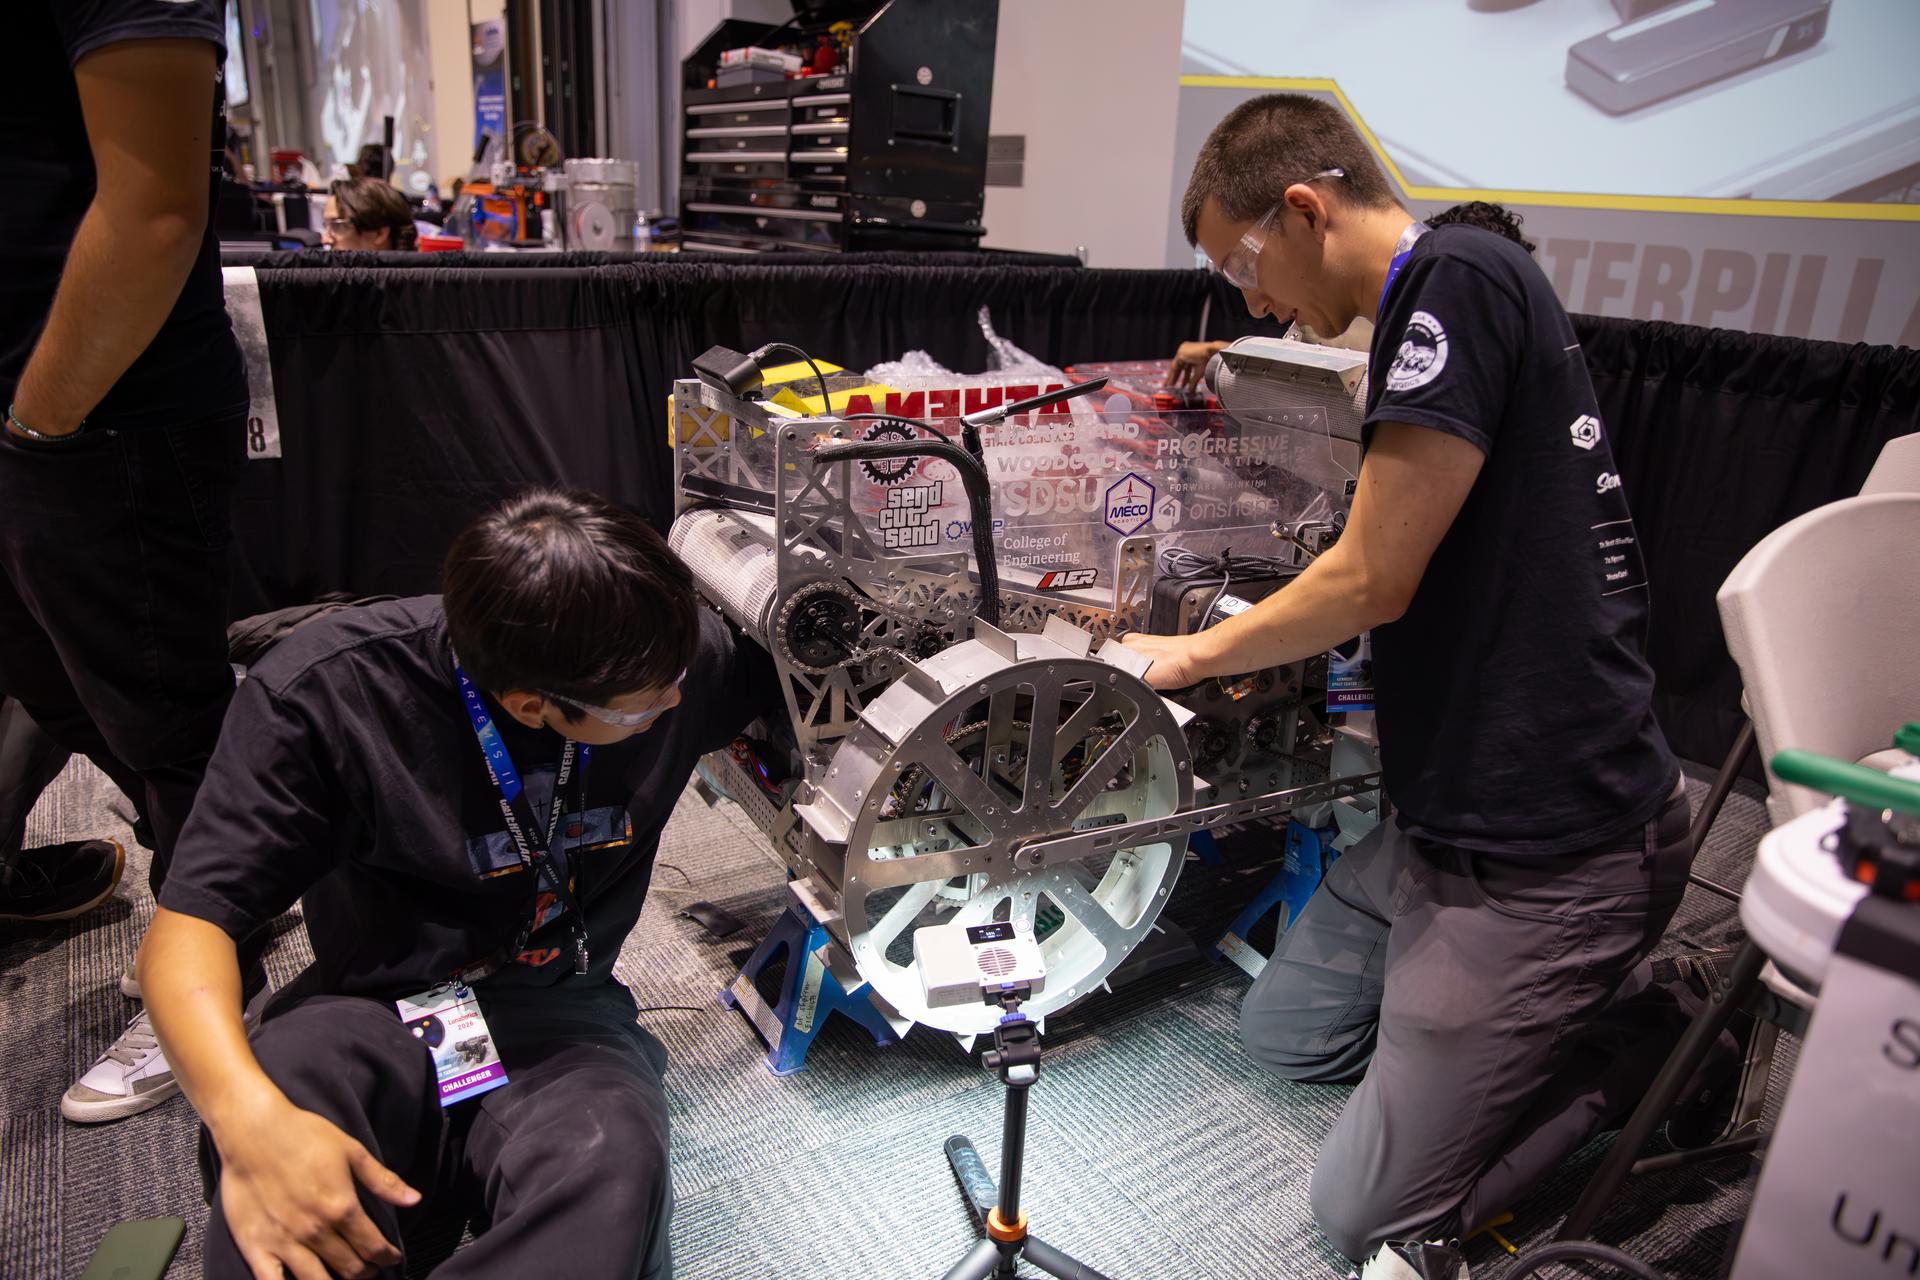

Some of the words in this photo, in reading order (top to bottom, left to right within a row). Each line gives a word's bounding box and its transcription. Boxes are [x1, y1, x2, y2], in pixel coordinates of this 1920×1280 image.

[1533, 236, 1920, 346] TERPILL
[1156, 428, 1289, 458] PROGRESSIVE
[997, 451, 1134, 473] WOODCOCK
[887, 480, 943, 510] send
[1005, 477, 1104, 517] SDSU
[879, 507, 922, 530] cut
[1110, 504, 1148, 519] MECO
[1190, 494, 1279, 521] onshape
[884, 520, 939, 549] send
[1003, 535, 1051, 551] College
[1053, 532, 1069, 547] of
[1003, 551, 1081, 568] Engineering
[1048, 568, 1098, 588] AER
[1338, 693, 1375, 701] CHALLENGE
[461, 677, 503, 759] ARTEMIS
[558, 737, 577, 785] CATERPI
[448, 1011, 478, 1025] Lunabotics
[442, 1069, 493, 1093] CHALLENGER
